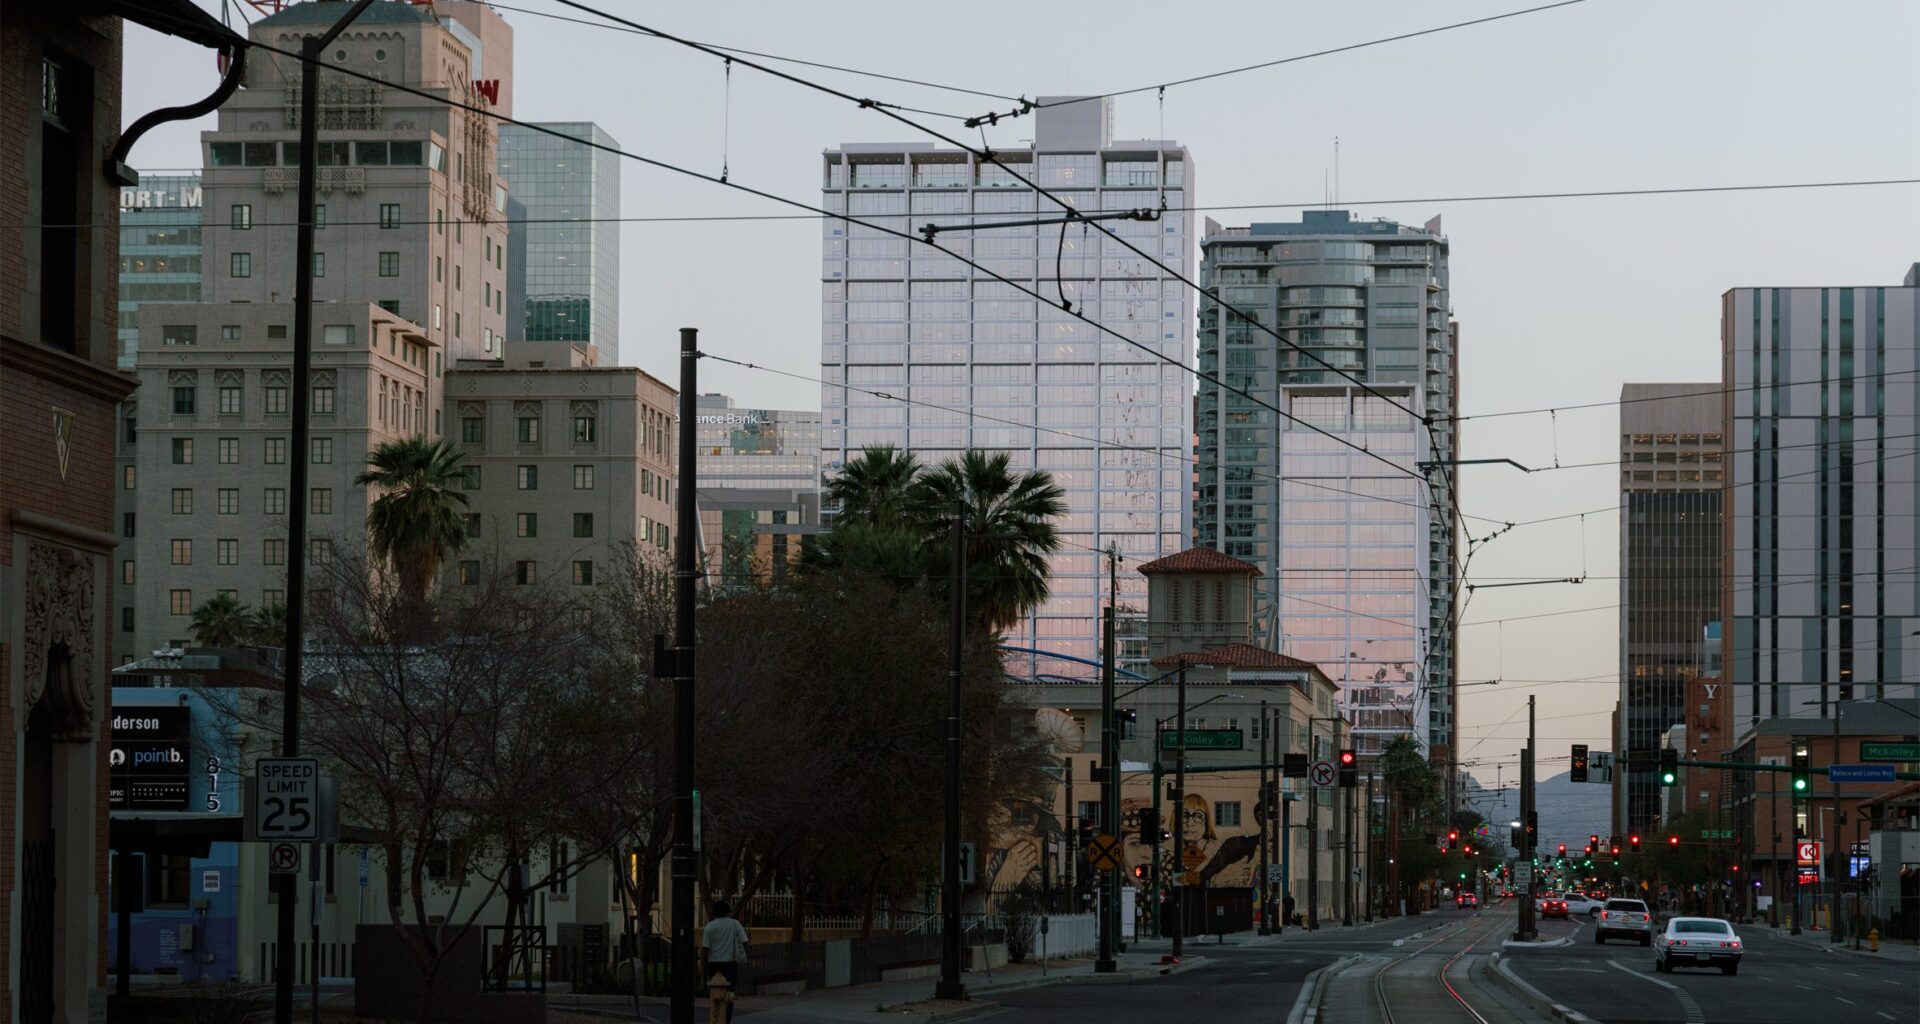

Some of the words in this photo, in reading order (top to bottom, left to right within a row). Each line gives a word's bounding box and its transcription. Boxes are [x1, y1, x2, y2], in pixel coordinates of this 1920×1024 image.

[727, 413, 758, 424] Bank
[1703, 684, 1718, 699] Y
[1169, 735, 1214, 745] MKinley
[1869, 747, 1915, 758] McKinley
[262, 765, 313, 778] SPEED
[267, 781, 307, 793] LIMIT
[263, 797, 311, 832] 25
[1269, 872, 1282, 881] 25
